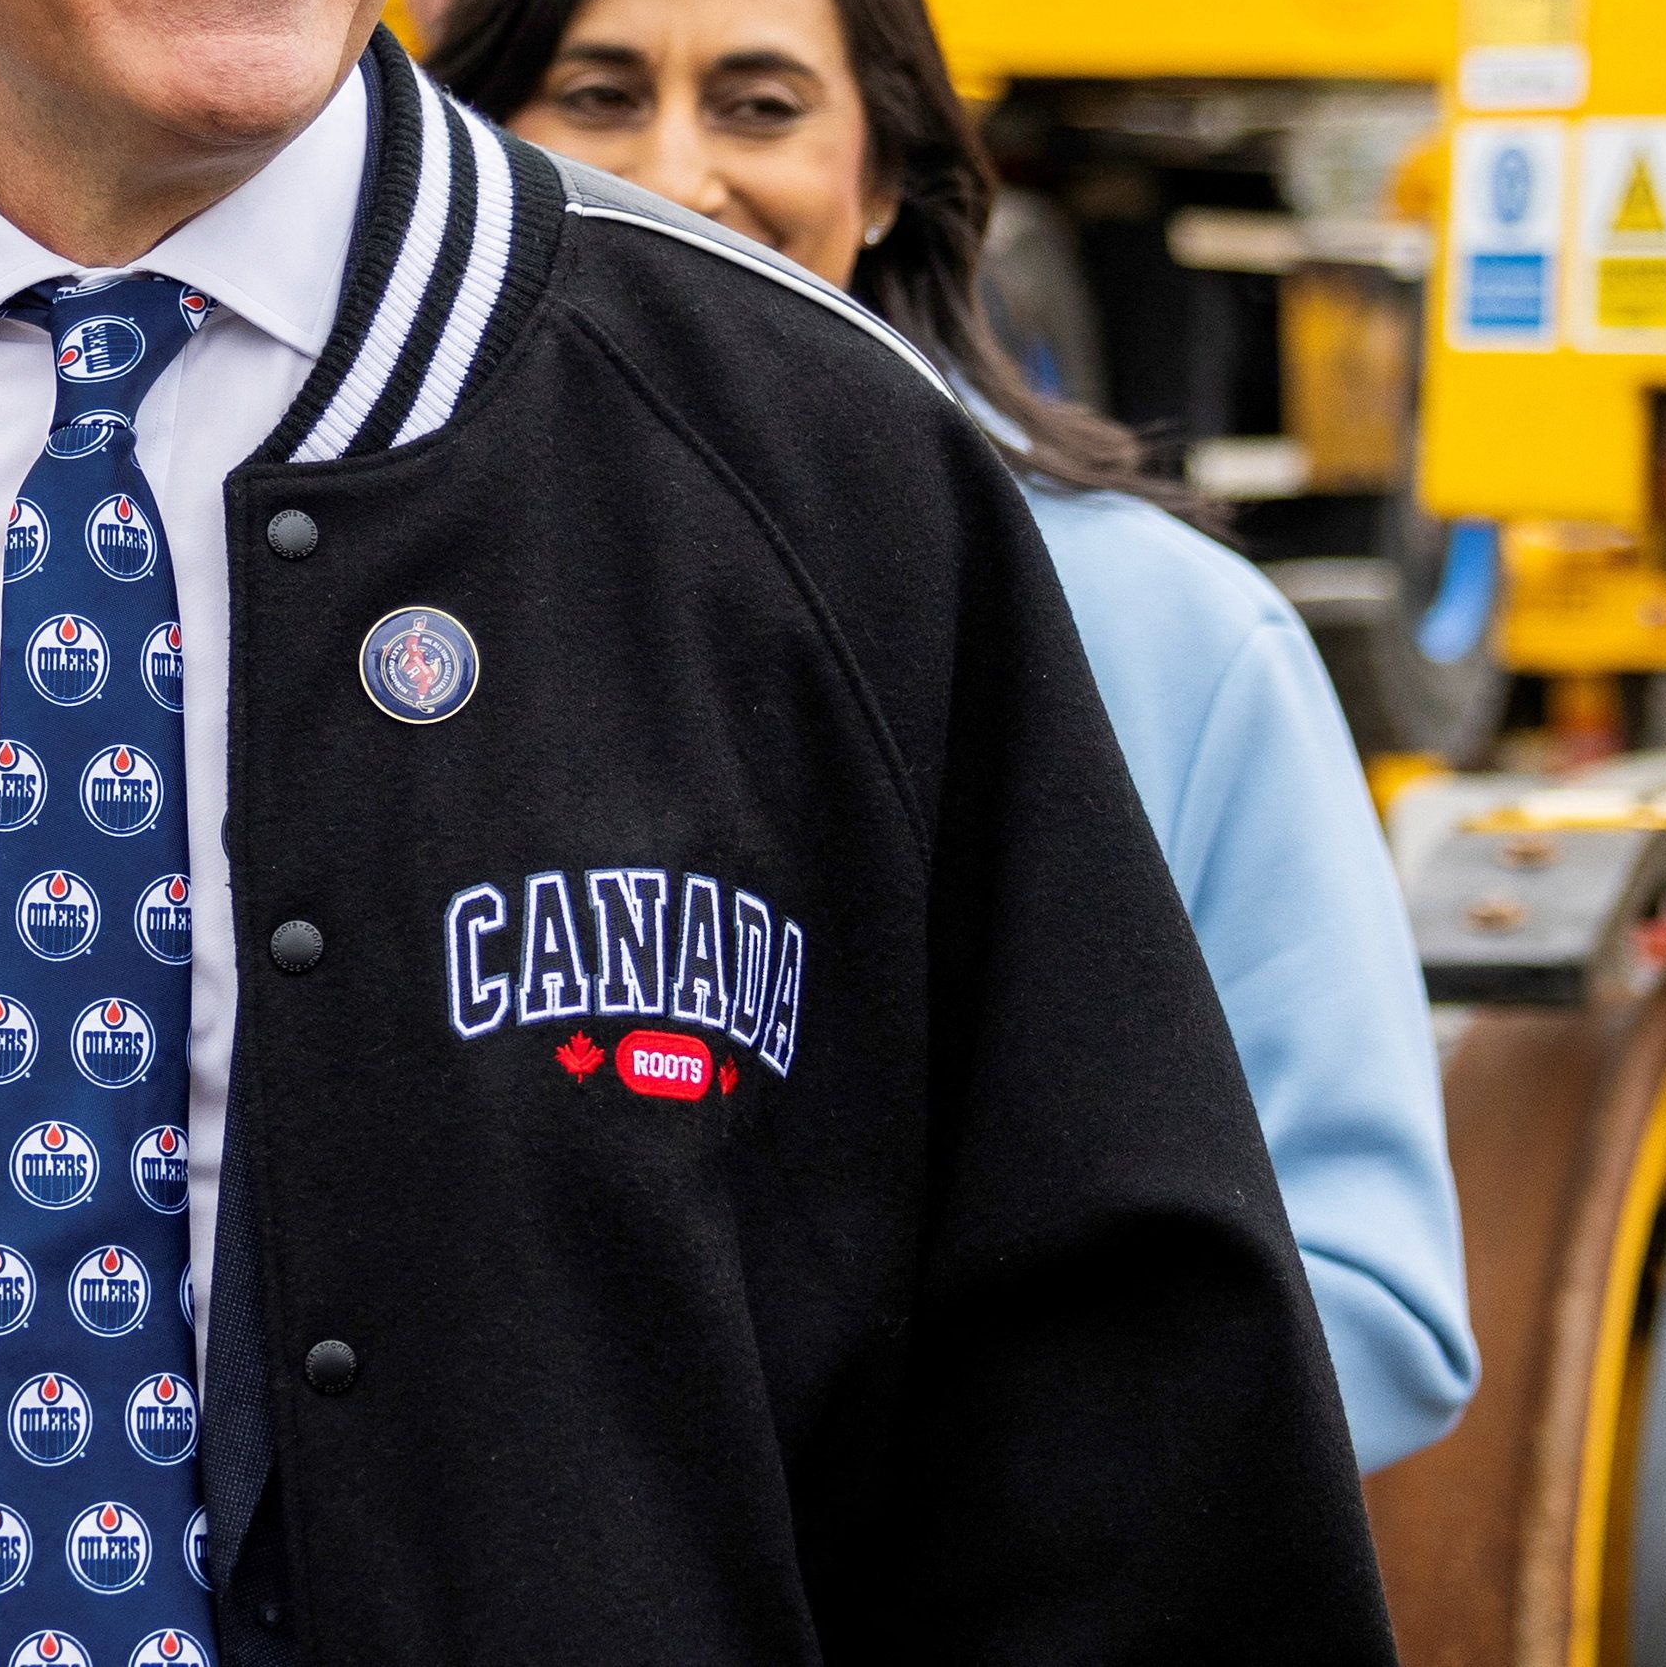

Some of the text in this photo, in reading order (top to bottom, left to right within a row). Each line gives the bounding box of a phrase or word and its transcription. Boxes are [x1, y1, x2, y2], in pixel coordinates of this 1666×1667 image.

[81, 323, 111, 374] OILERS
[97, 523, 148, 550] OILERS
[37, 646, 100, 672] OILERS
[91, 777, 153, 802] OILERS
[27, 902, 89, 928] OILERS
[443, 867, 803, 1079] CANADA
[82, 1030, 144, 1056] OILERS
[631, 1048, 703, 1084] ROOTS
[21, 1153, 88, 1177] OILERS
[140, 1157, 189, 1182] OILERS
[80, 1278, 140, 1303] OILERS
[19, 1406, 81, 1432] OILERS
[136, 1406, 193, 1431] OILERS
[78, 1535, 141, 1560] OILERS
